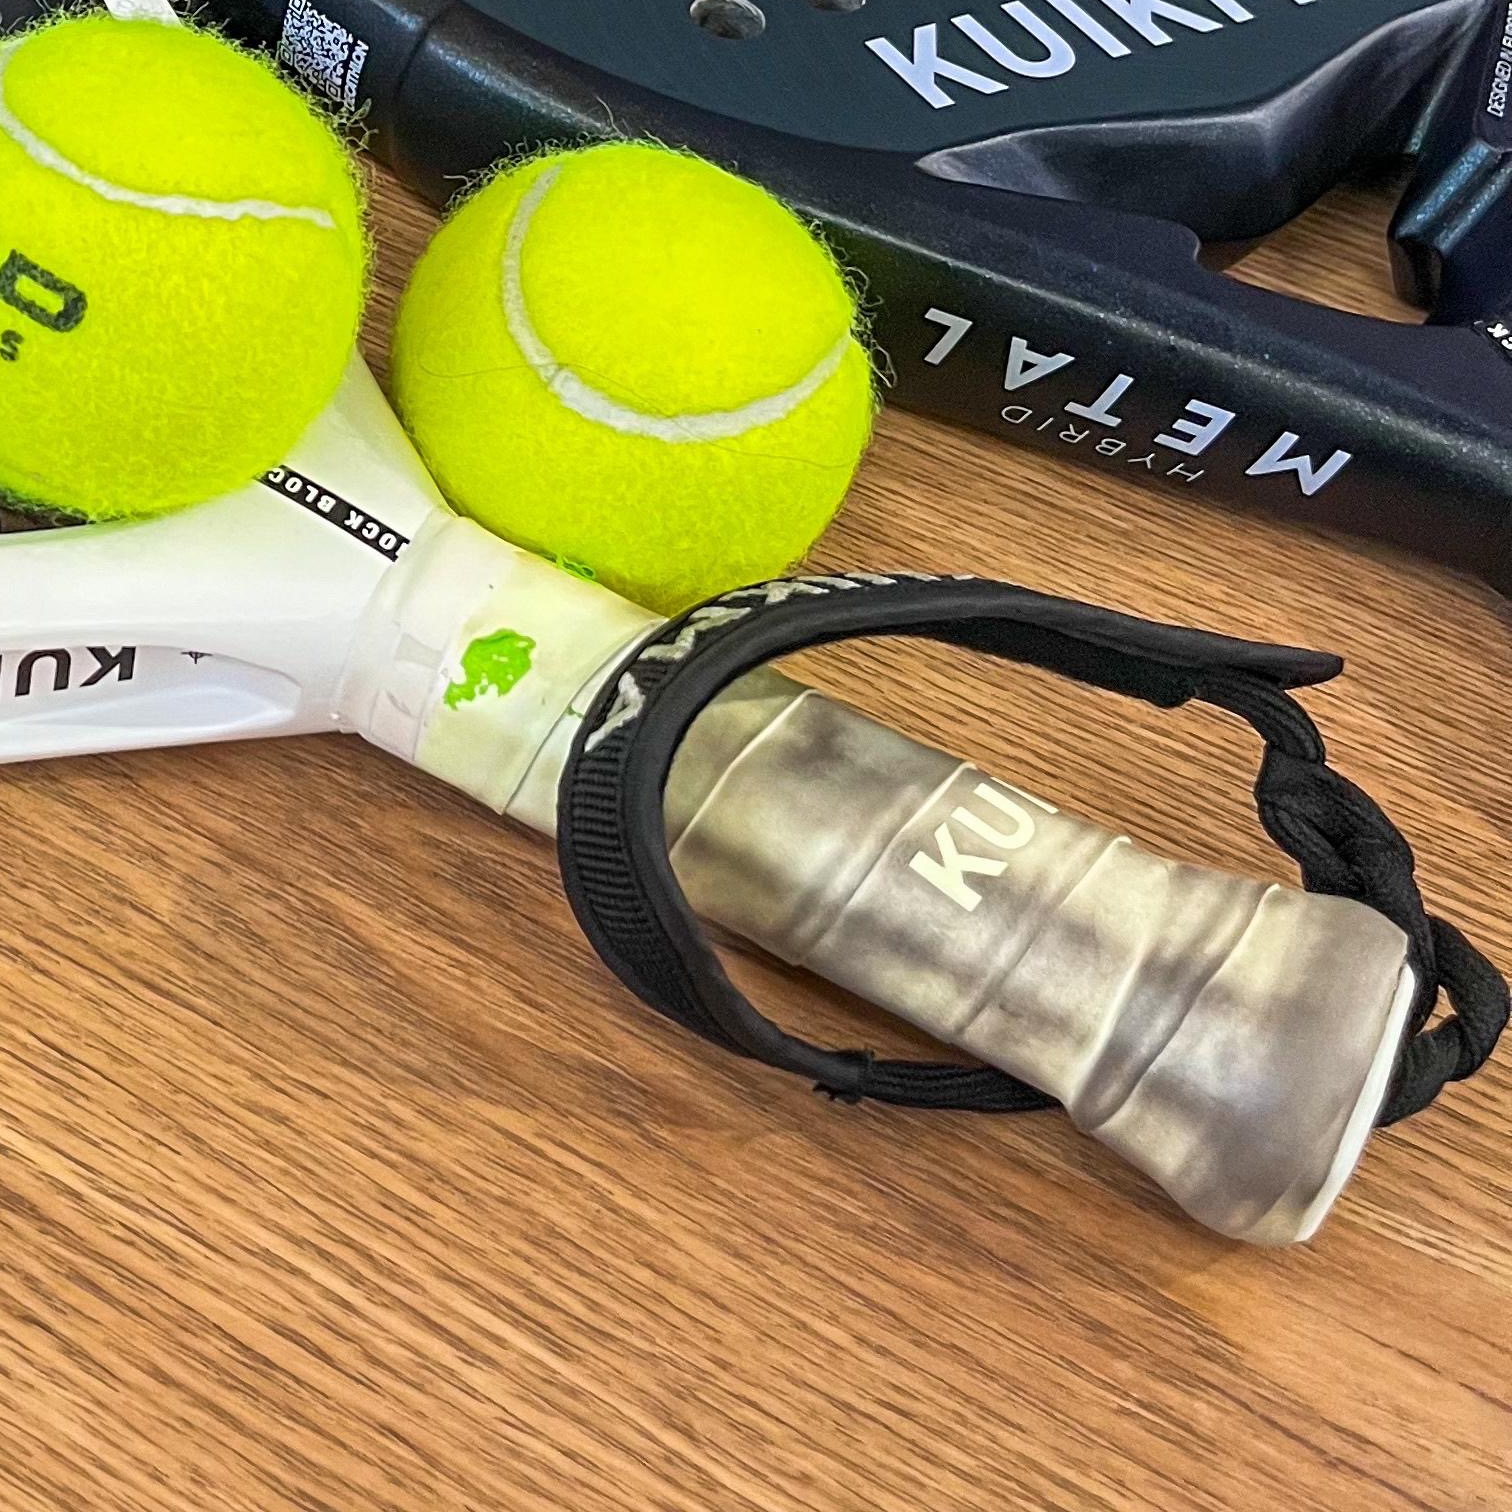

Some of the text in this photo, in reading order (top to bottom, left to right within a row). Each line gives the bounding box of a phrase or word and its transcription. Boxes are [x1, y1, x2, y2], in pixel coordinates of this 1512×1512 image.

[344, 39, 369, 112] DECATHLON
[923, 306, 1353, 496] METAL
[1000, 403, 1205, 484] HYBRID
[267, 467, 337, 514] BLOC
